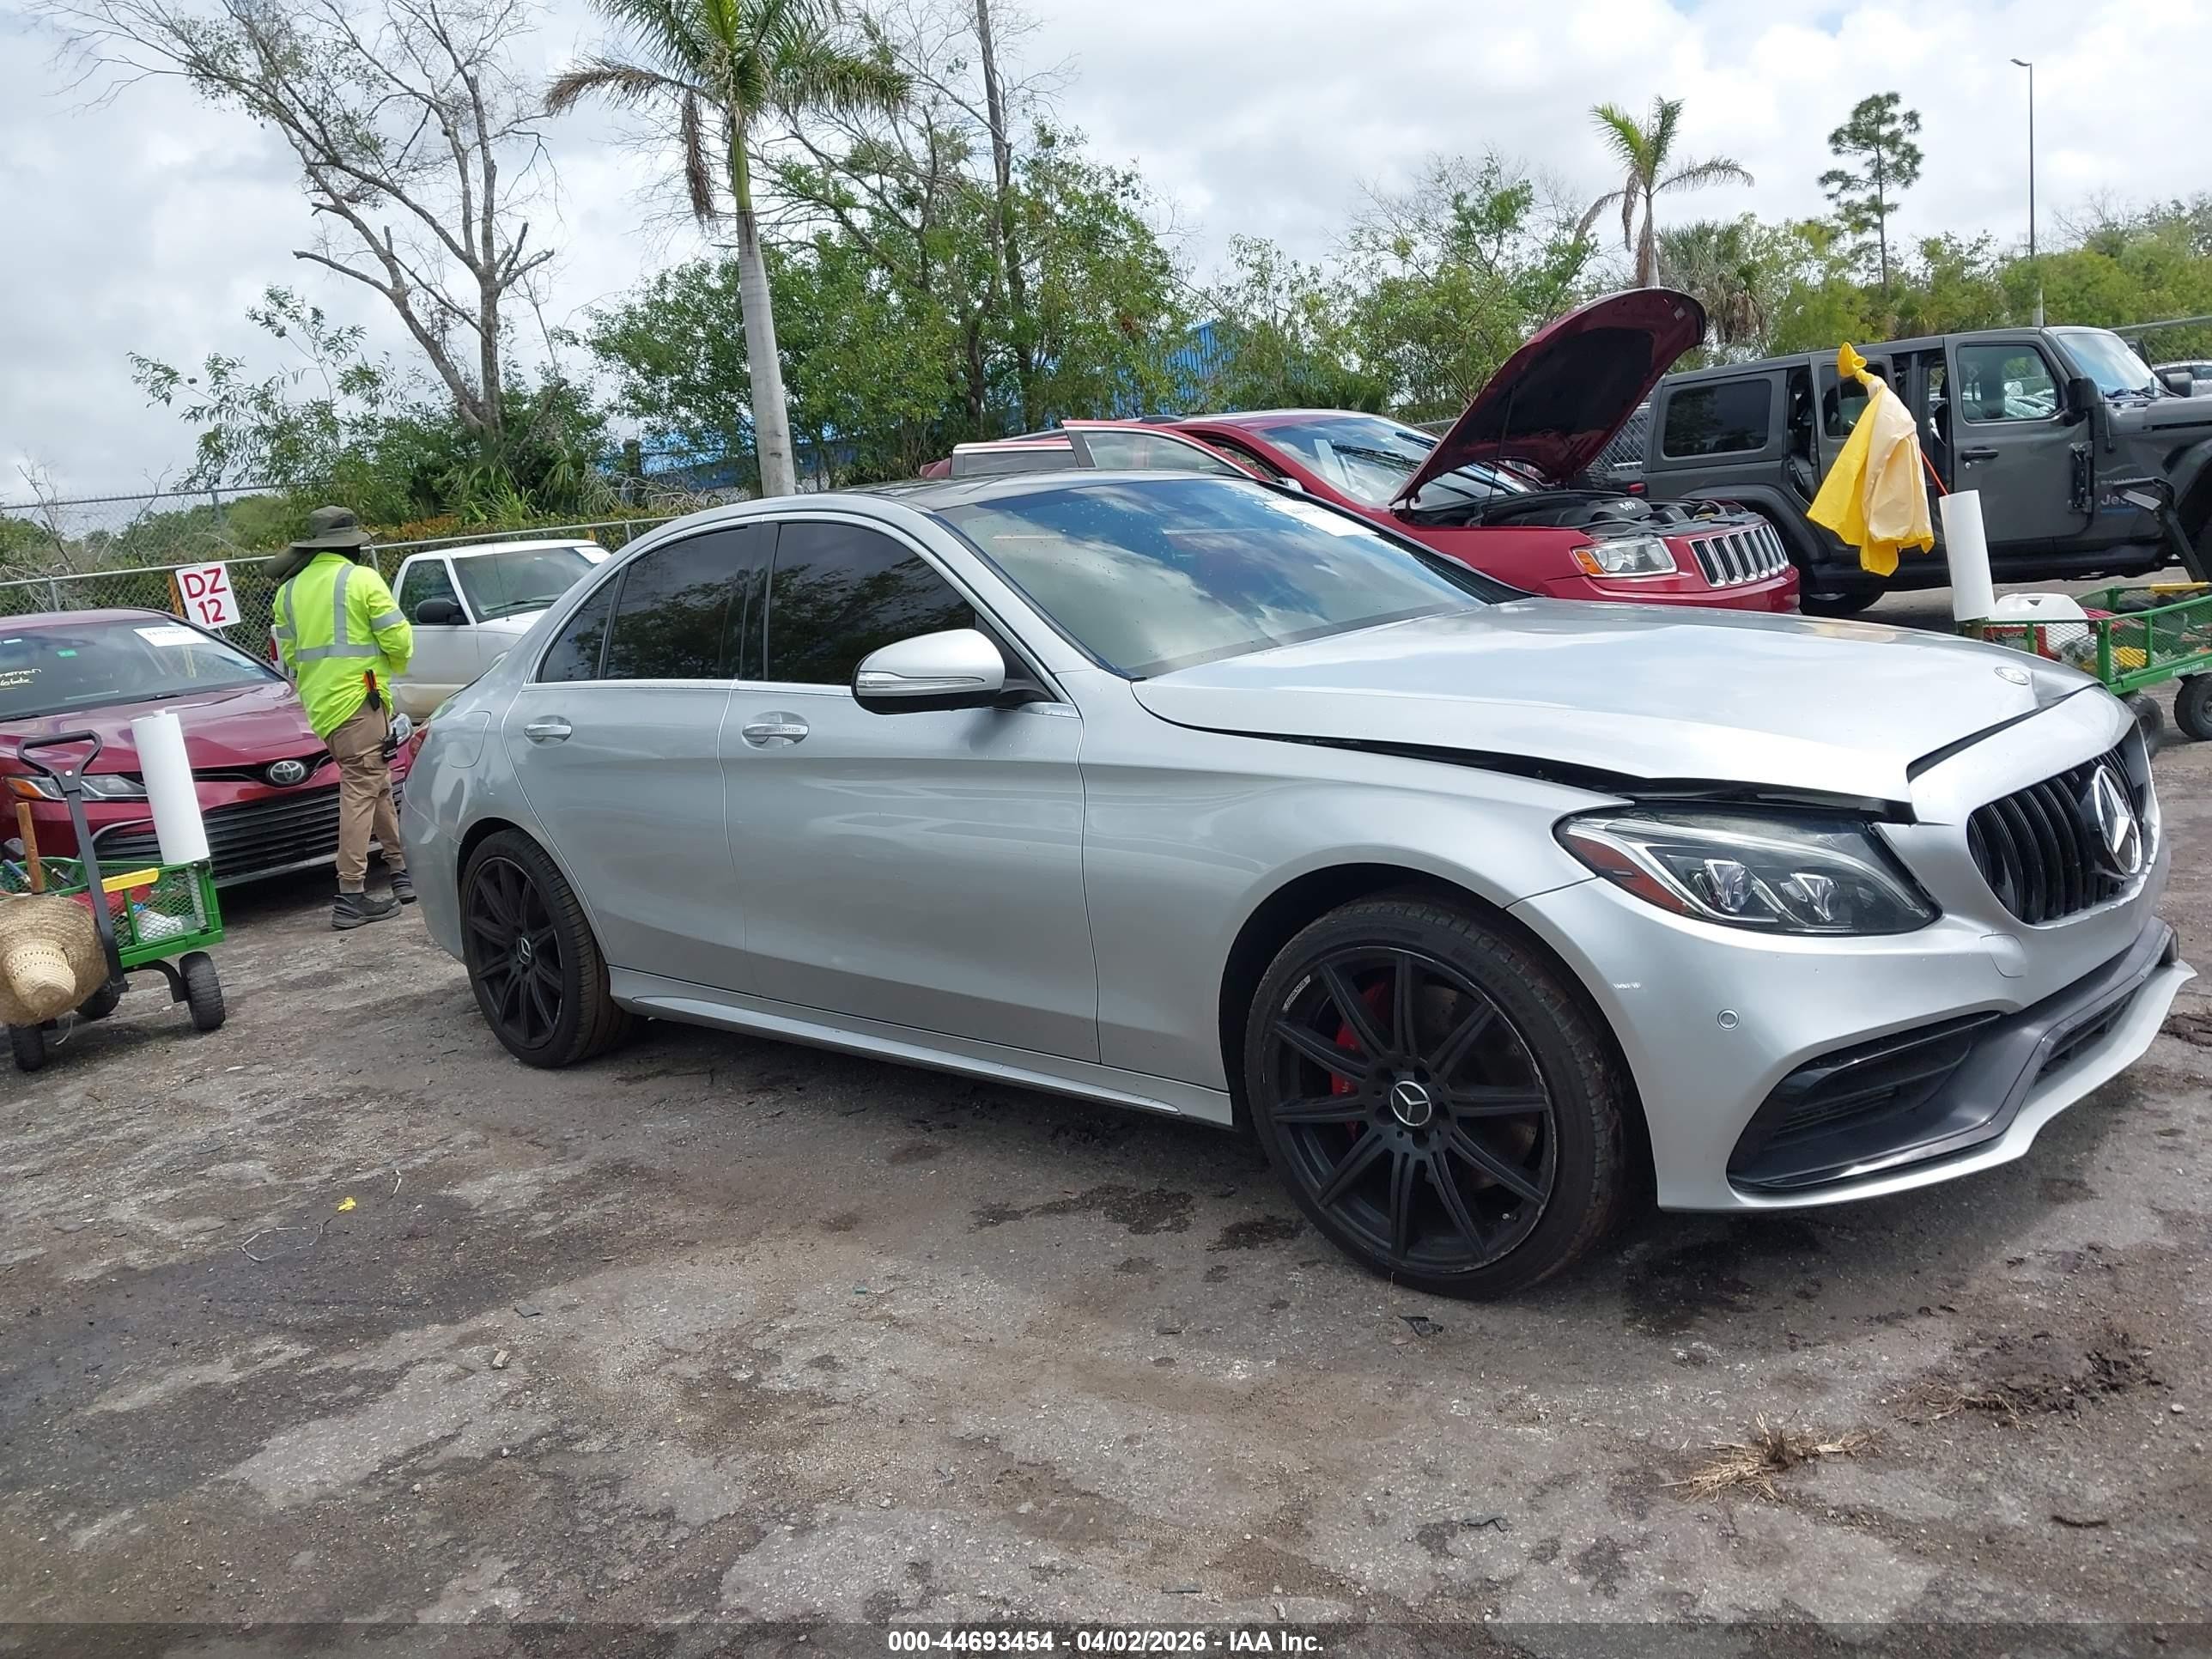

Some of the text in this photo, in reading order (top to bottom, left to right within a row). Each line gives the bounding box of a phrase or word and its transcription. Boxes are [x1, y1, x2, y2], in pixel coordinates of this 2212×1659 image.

[2100, 494, 2133, 506] Je
[182, 567, 228, 599] DZ
[198, 598, 226, 624] 12
